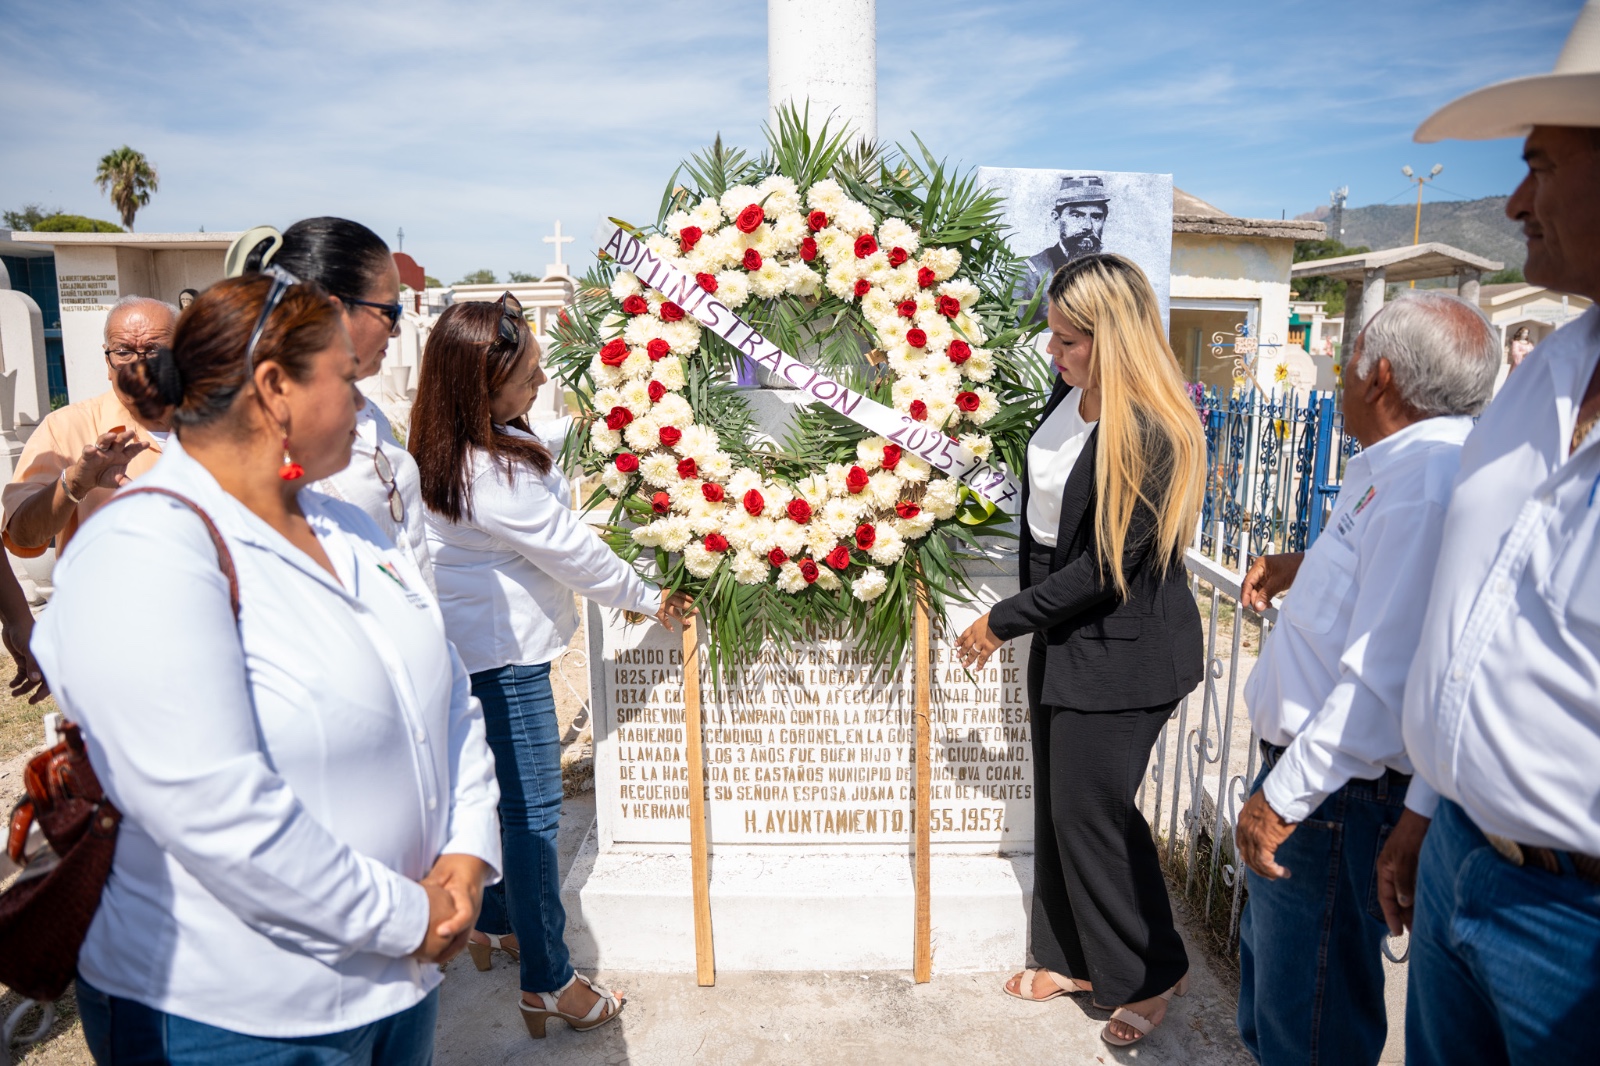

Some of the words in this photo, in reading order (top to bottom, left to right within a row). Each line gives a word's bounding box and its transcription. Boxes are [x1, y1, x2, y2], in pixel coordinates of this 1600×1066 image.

[604, 227, 863, 416] ADMINISTRACION
[886, 416, 1018, 504] 2025-2027
[614, 648, 664, 665] NACIDO
[669, 648, 684, 665] EN
[1001, 646, 1016, 664] DE
[810, 669, 856, 686] LUGAR
[944, 667, 998, 685] AGOSTO
[1002, 667, 1020, 684] DE
[772, 689, 788, 705] DE
[794, 688, 821, 706] UNA
[826, 688, 894, 706] AFECCION
[974, 687, 1000, 706] QUE
[1005, 686, 1023, 704] LE
[711, 708, 727, 725] LA
[790, 708, 839, 726] CONTRA
[843, 708, 859, 725] LA
[963, 706, 1031, 725] FRANCESA
[617, 727, 684, 745] HABIENDO
[768, 728, 775, 745] A
[867, 727, 884, 745] LA
[946, 727, 963, 745] DE
[967, 726, 1032, 744] REFORMA.
[618, 746, 680, 764] LLAMADA
[737, 747, 745, 763] 3
[788, 747, 816, 764] FUE
[820, 747, 857, 764] BUEN
[861, 746, 892, 764] HIJO
[896, 747, 903, 763] Y
[947, 746, 1029, 763] CIUDADANO.
[619, 765, 637, 782] DE
[641, 765, 658, 783] LA
[733, 766, 750, 783] DE
[754, 764, 824, 784] CASTAÑOS
[828, 766, 892, 783] MUNICIPIO
[896, 766, 912, 783] DE
[985, 765, 1025, 782] COAH.
[619, 784, 689, 801] RECUERDO
[714, 785, 733, 801] SU
[736, 783, 789, 801] SEÑORA
[851, 784, 895, 801] JUANA
[955, 784, 969, 800] DE
[972, 783, 1032, 800] FUENTES
[621, 803, 629, 819] Y
